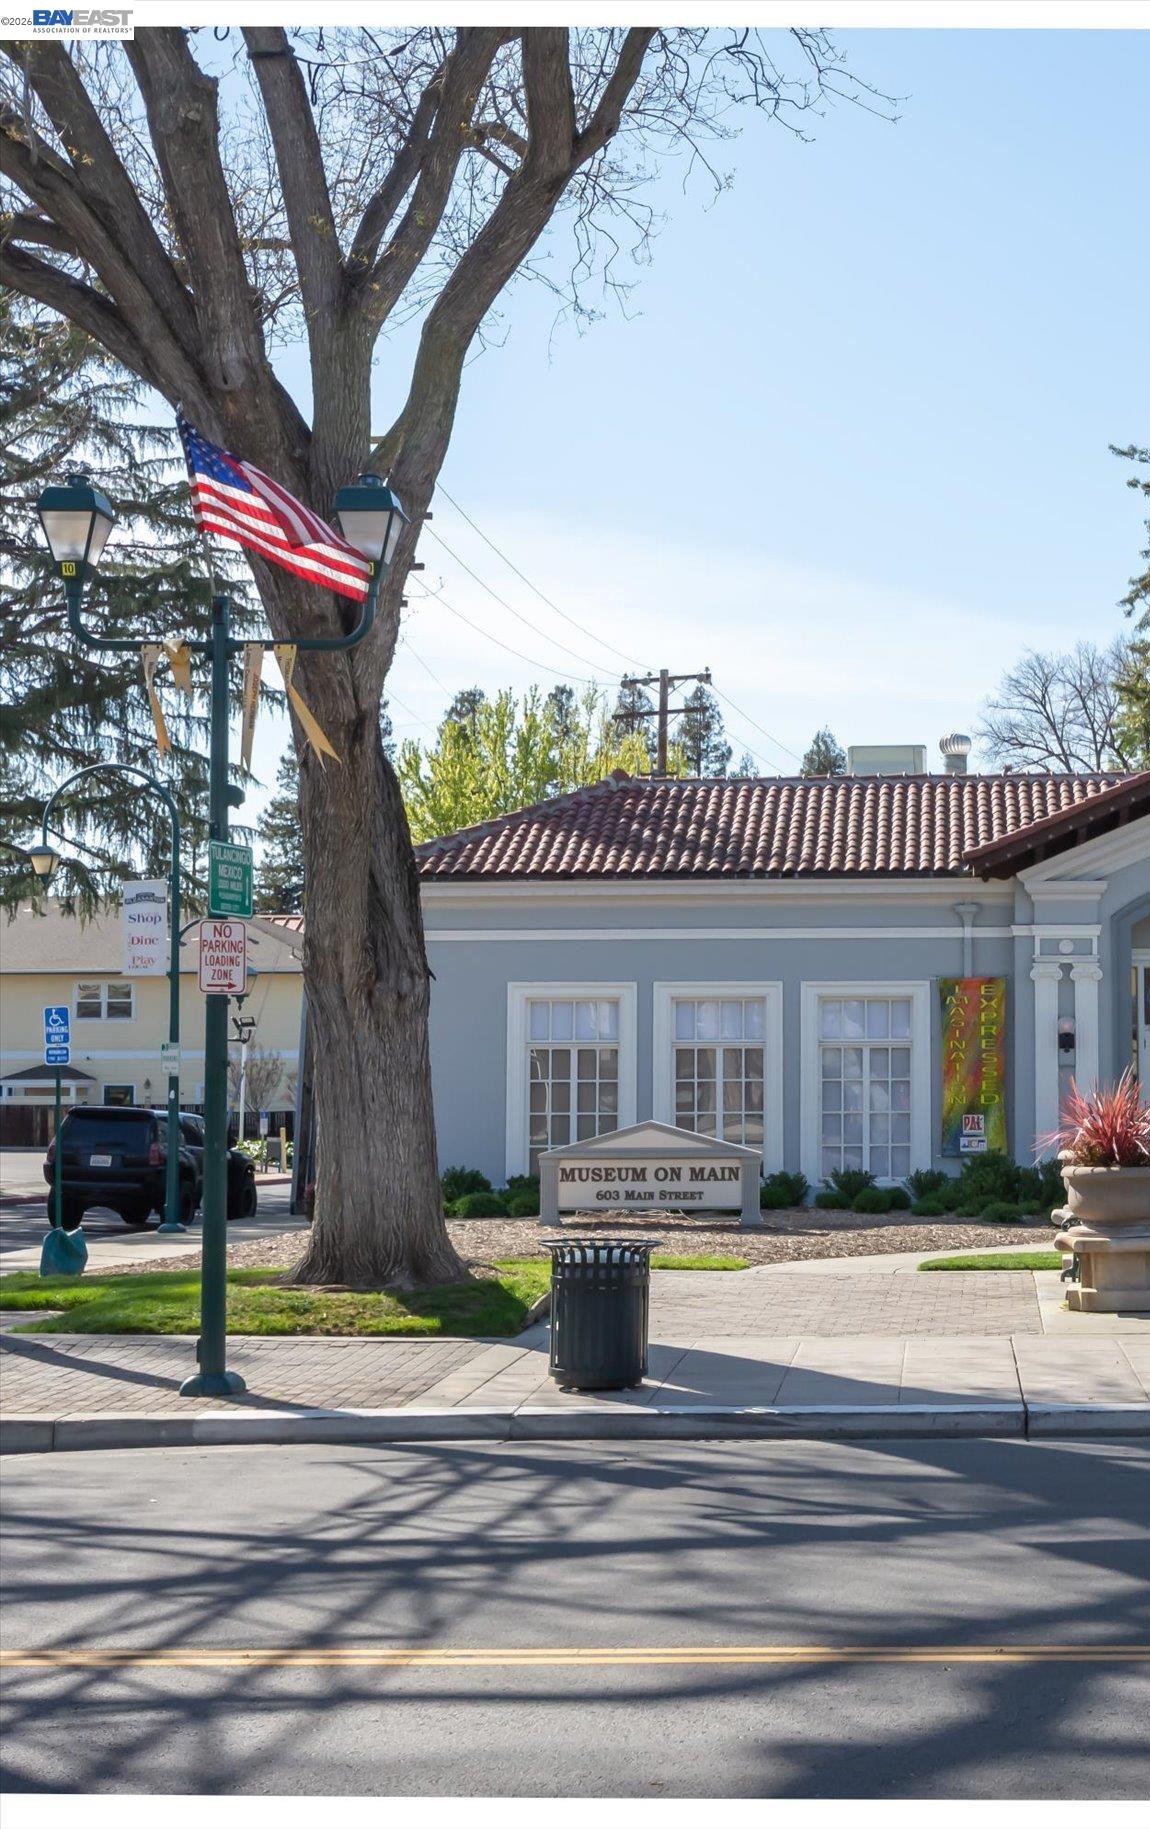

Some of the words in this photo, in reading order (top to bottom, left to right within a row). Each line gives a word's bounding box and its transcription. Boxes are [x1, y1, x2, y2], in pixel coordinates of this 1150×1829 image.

[64, 563, 74, 574] 10
[218, 864, 243, 879] MEXICO
[128, 913, 162, 925] Shop
[213, 925, 232, 938] NO
[202, 940, 243, 953] PARKING
[204, 955, 240, 967] LOADING
[211, 969, 233, 981] ZONE
[980, 984, 999, 1105] EXPRESSED
[559, 1167, 647, 1182] MUSEUM
[654, 1167, 682, 1182] ON
[689, 1166, 741, 1182] MAIN
[596, 1190, 620, 1200] 603
